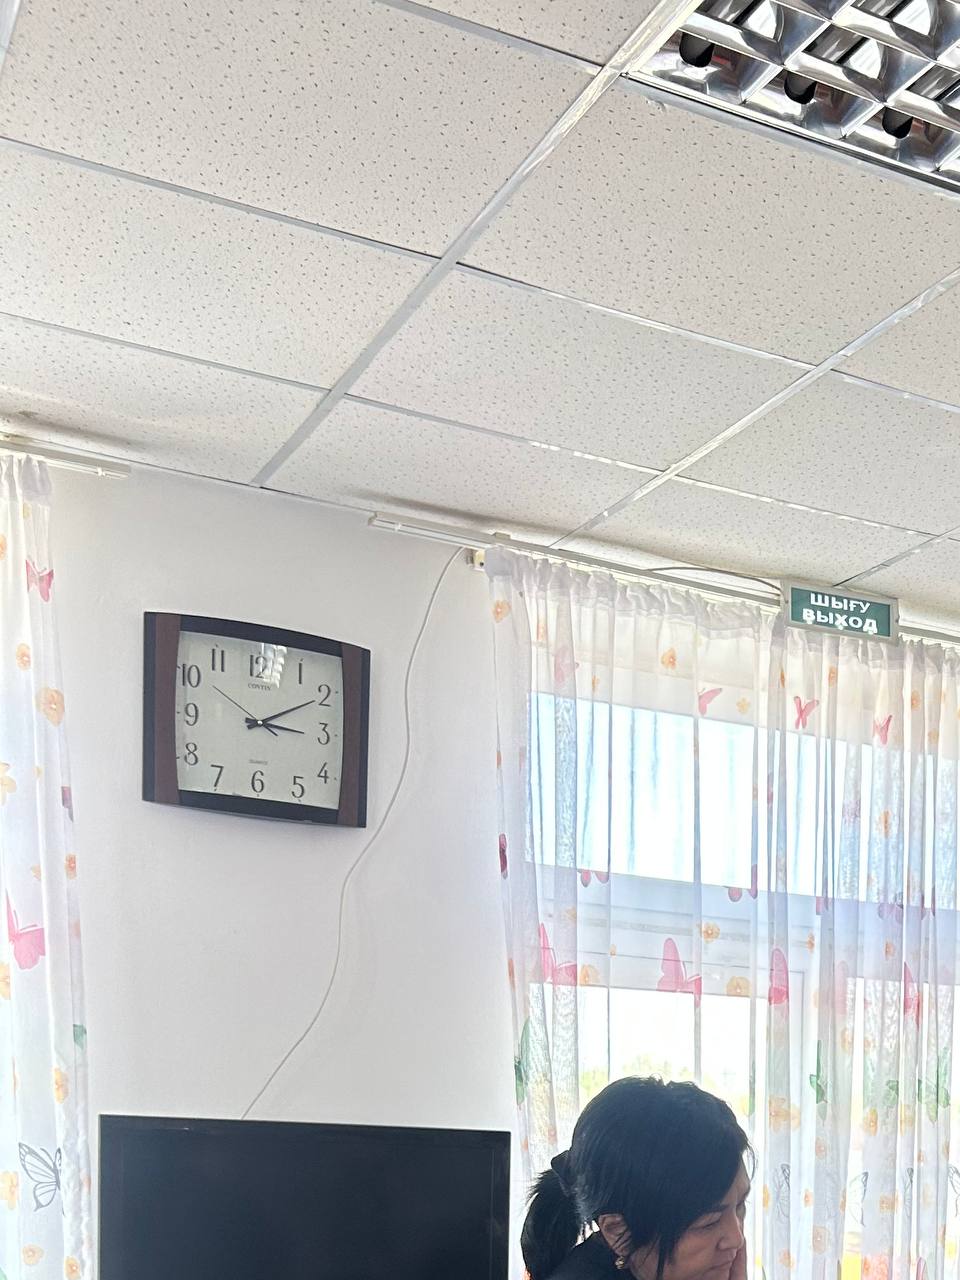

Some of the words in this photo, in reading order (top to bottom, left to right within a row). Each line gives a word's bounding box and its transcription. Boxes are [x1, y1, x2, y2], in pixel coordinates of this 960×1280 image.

[810, 592, 870, 613] ШЫҒУ
[802, 608, 878, 634] ВЫХОД
[211, 648, 225, 672] 11
[249, 654, 267, 679] 12
[181, 663, 202, 688] 10
[317, 684, 331, 707] 2
[184, 702, 199, 726] 9
[317, 722, 331, 745] 3
[183, 742, 199, 766] 8
[210, 764, 224, 788] 7
[251, 770, 265, 794] 6
[317, 762, 329, 784] 4
[291, 775, 305, 799] 5
